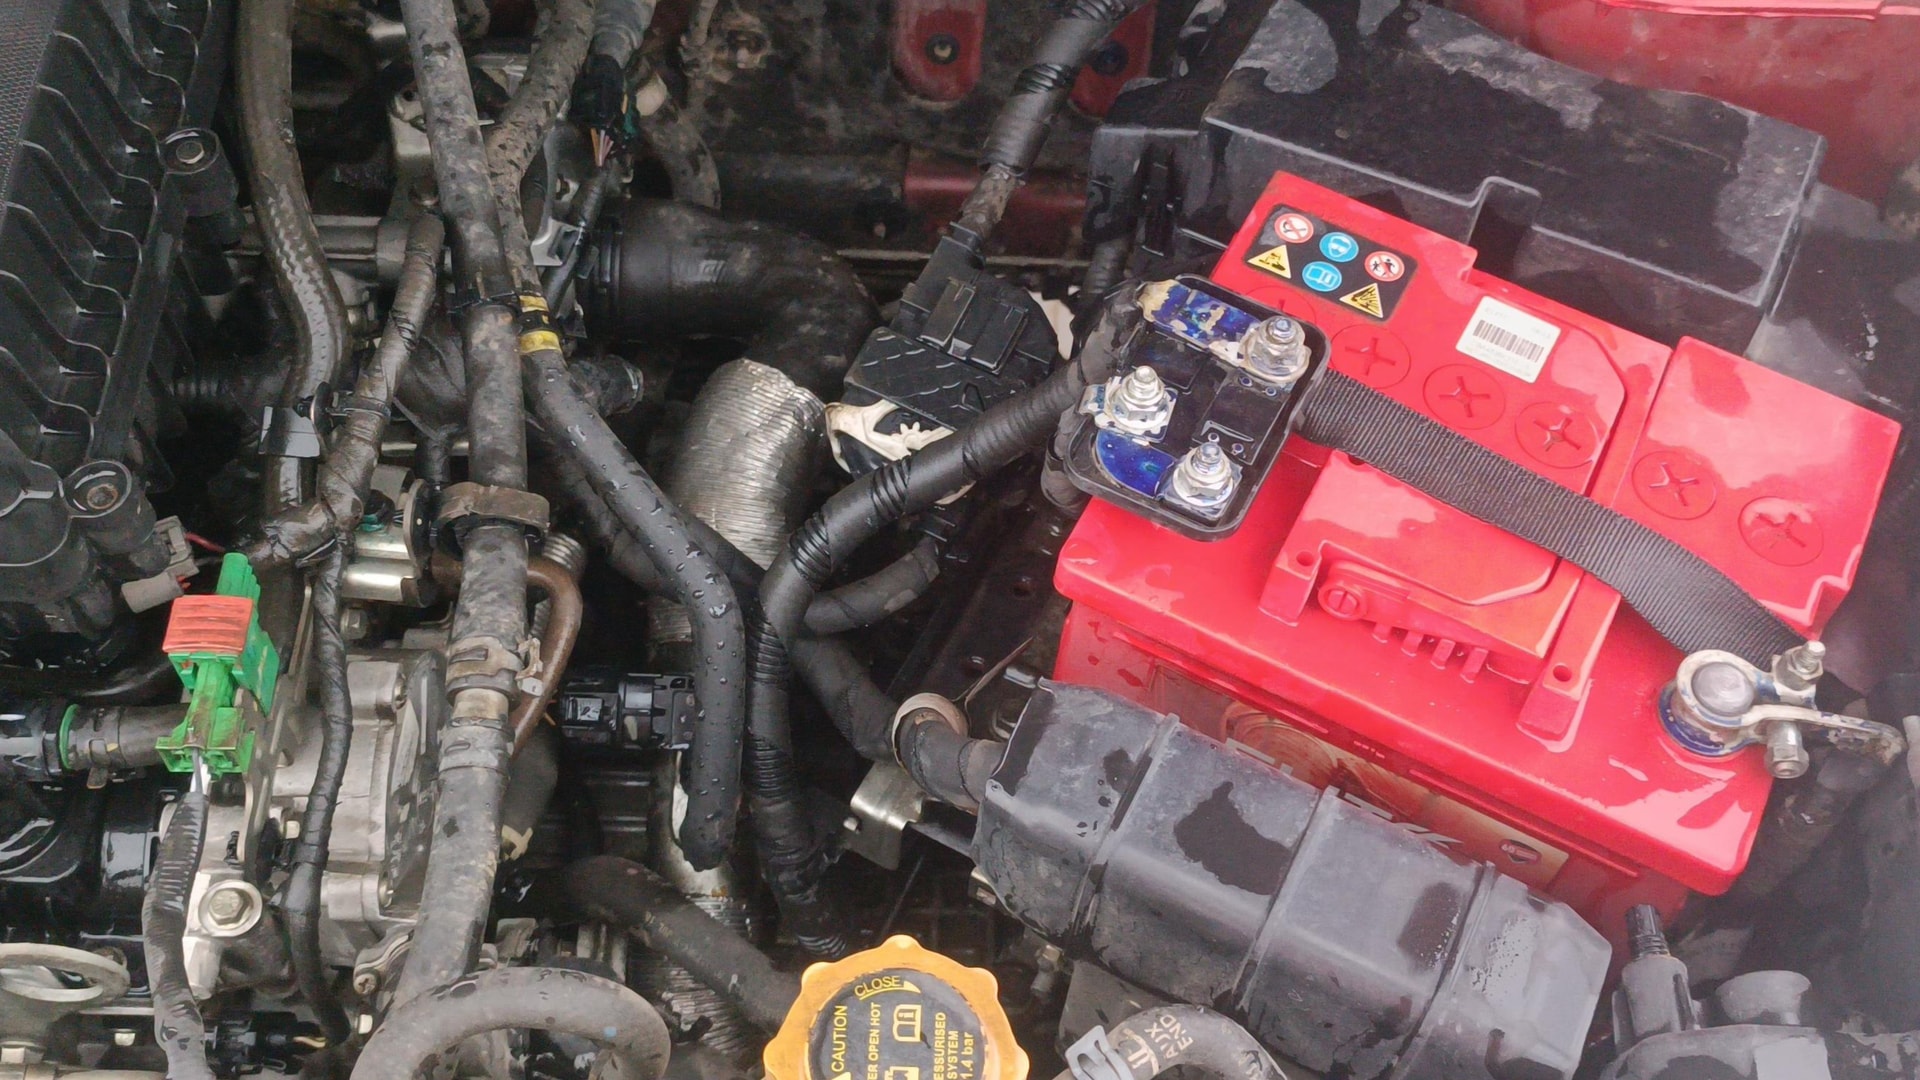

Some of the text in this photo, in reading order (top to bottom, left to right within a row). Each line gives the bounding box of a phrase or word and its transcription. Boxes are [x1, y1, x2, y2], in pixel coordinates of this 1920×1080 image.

[854, 975, 901, 997] CLOSE
[831, 1005, 848, 1072] CAUTION
[867, 1002, 881, 1080] ER OPEN HOT
[933, 1012, 946, 1080] ESSURISED
[947, 1030, 959, 1080] SYSTEM
[960, 1031, 974, 1080] 1.4 bar
[1144, 1022, 1179, 1060] AUX
[1160, 1014, 1194, 1052] END
